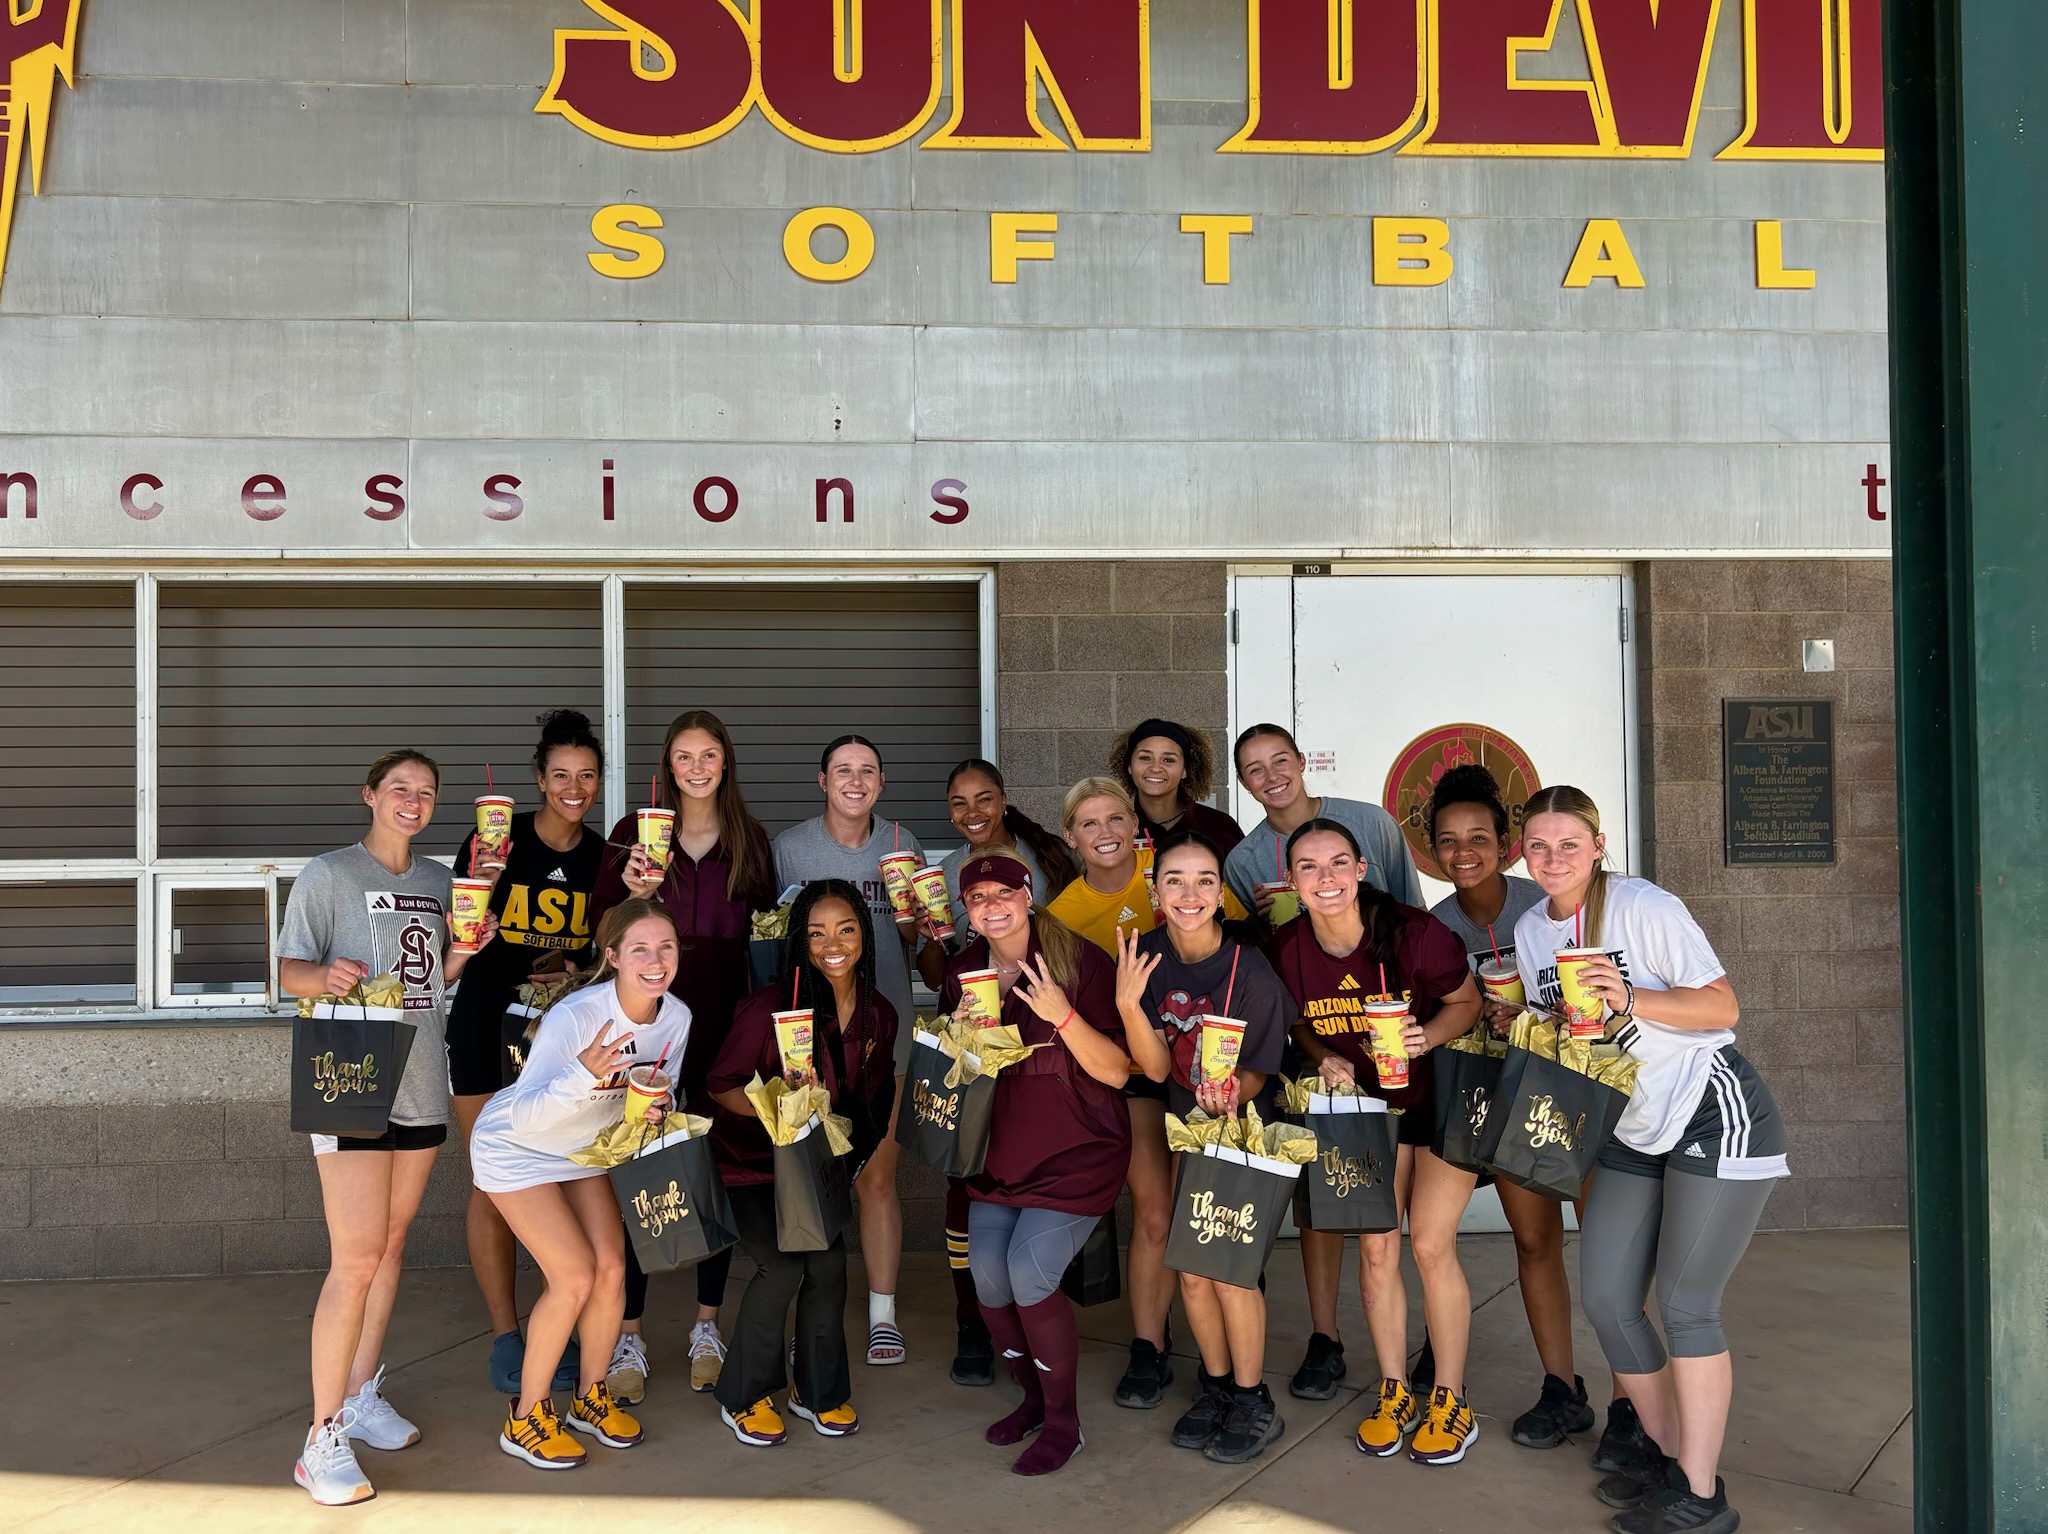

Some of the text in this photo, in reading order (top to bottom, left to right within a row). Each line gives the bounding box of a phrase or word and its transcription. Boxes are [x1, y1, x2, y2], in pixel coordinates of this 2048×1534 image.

[533, 0, 1151, 153] SUN
[1304, 565, 1320, 574] 110
[1744, 706, 1814, 738] ASU
[1771, 754, 1789, 765] The
[1733, 765, 1828, 777] Alberta B. Farrington
[1754, 775, 1807, 785] Foundation
[1734, 820, 1829, 832] Alberta B. Farrington
[1744, 831, 1820, 840] Softball Stadium
[1807, 851, 1827, 859] 2000
[399, 900, 415, 908] SUN
[1117, 912, 1139, 923] adidas
[523, 933, 574, 949] SOFTBALL
[1304, 997, 1364, 1018] ARIZONA
[1312, 1017, 1349, 1036] SUN
[323, 1078, 367, 1103] you
[914, 1104, 948, 1129] you
[1529, 1123, 1574, 1152] you
[1684, 1150, 1706, 1158] adidas
[1336, 1172, 1373, 1198] you
[649, 1208, 679, 1238] you
[1197, 1220, 1242, 1244] you
